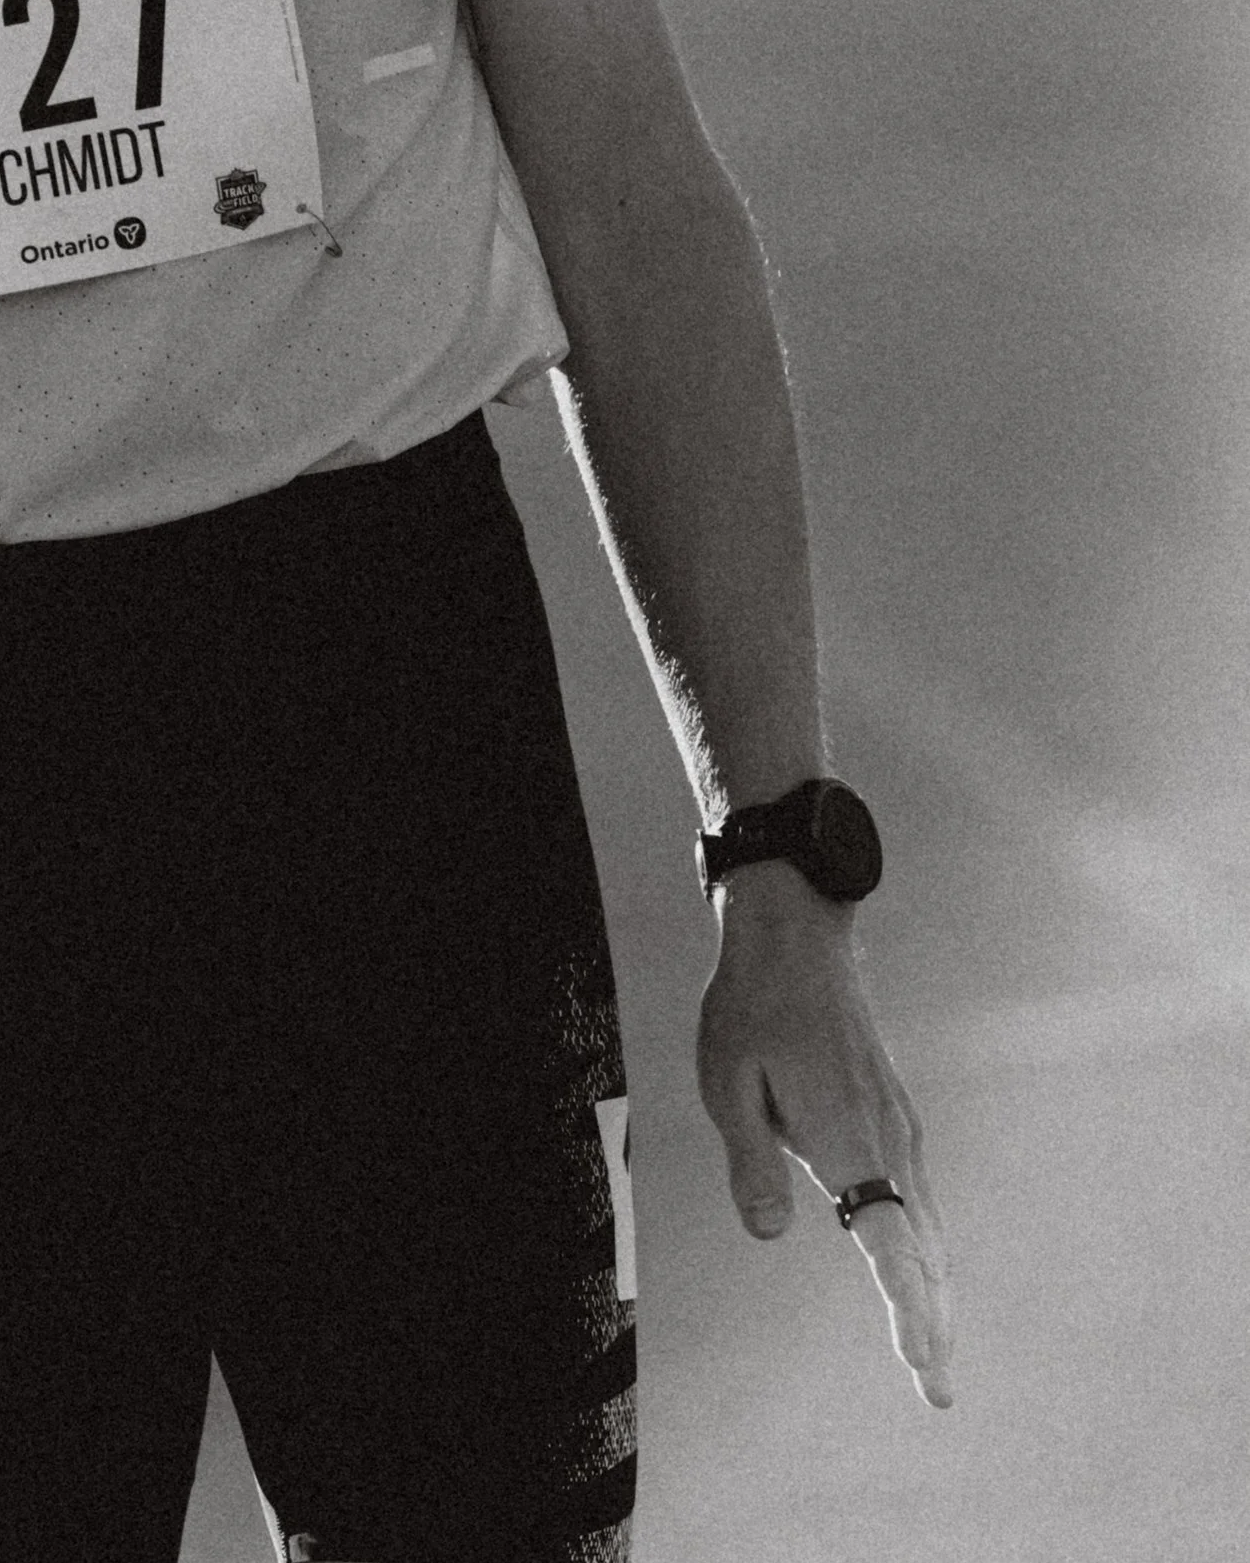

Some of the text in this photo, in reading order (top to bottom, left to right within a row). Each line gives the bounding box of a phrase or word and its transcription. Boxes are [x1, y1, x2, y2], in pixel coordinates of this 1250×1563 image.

[223, 183, 254, 198] TRACK
[234, 194, 258, 207] FIELD
[20, 234, 109, 264] Ontario
